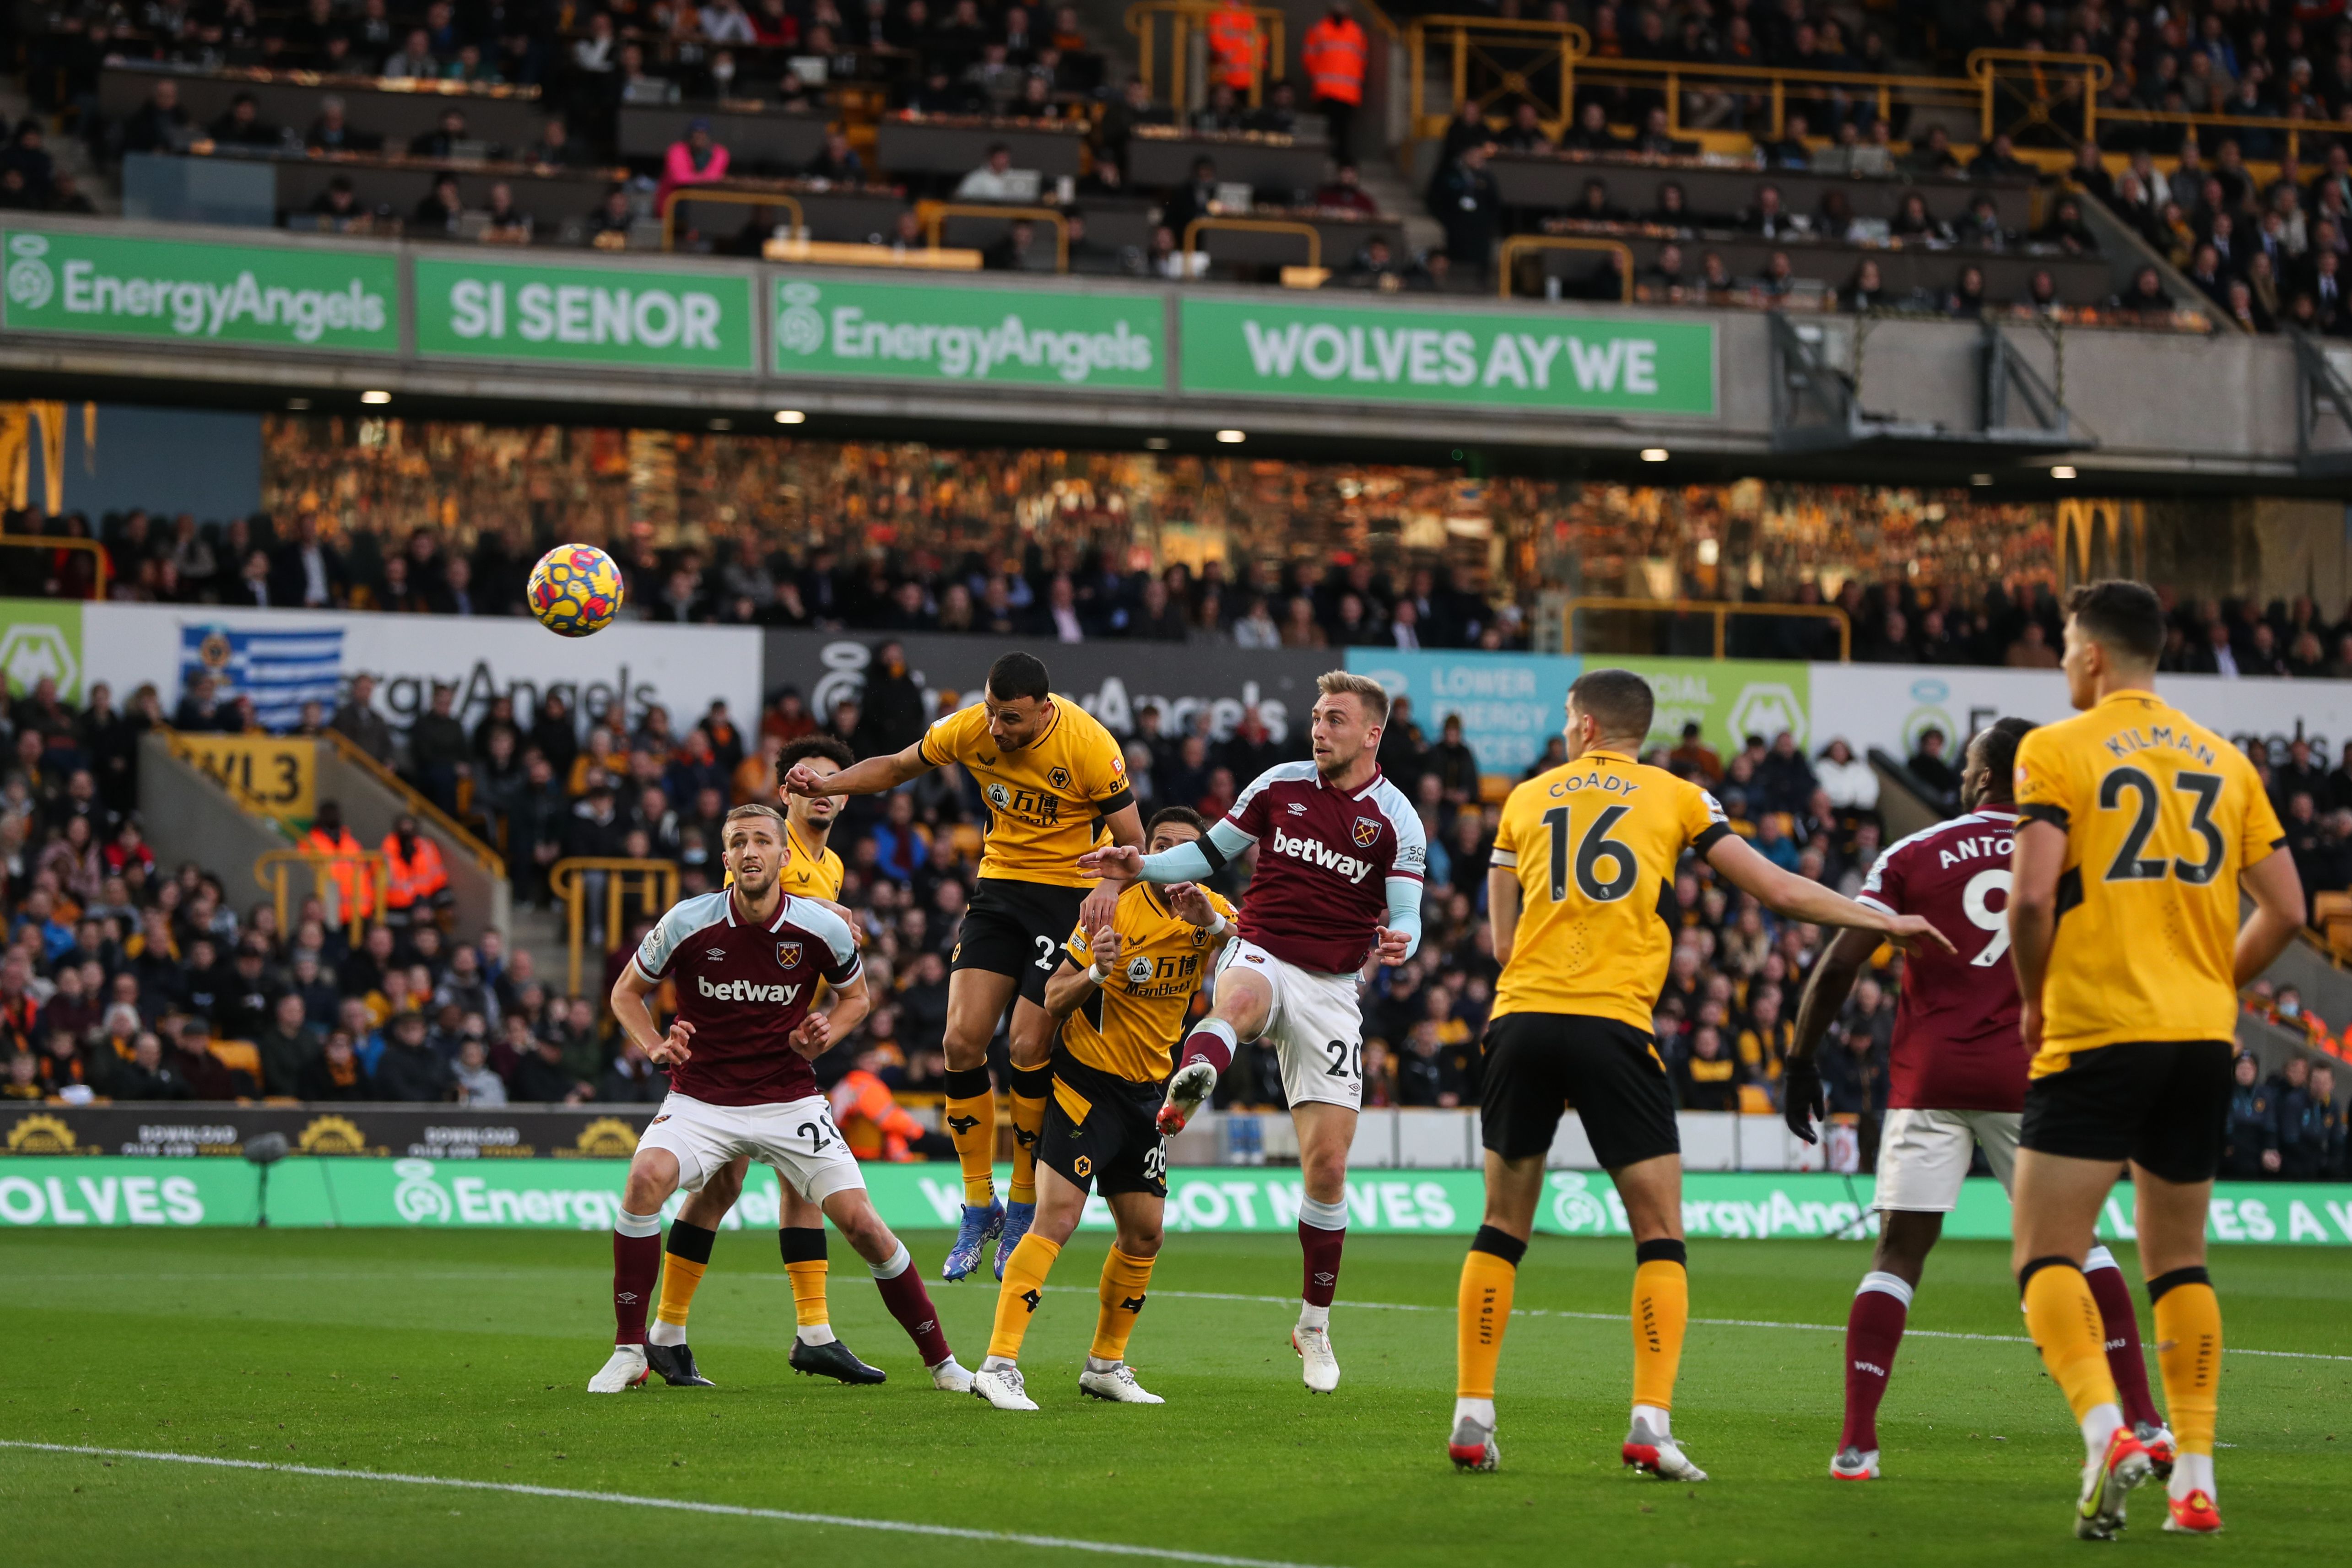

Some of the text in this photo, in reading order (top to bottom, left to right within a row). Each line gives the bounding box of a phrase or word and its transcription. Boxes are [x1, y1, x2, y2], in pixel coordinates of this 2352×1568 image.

[63, 260, 386, 343] EnergyAngels
[450, 278, 721, 350] SI SENOR
[831, 305, 1153, 384] EnergyAngels
[1243, 319, 1659, 395] WOLVES AY WE
[1431, 666, 1536, 700] LOWER
[2104, 726, 2215, 767] KILMAN
[1549, 772, 1640, 798] COADY
[2099, 766, 2225, 885] 23
[1273, 827, 1374, 884] betway
[1540, 805, 1639, 903] 16
[1963, 869, 2015, 967] 9
[698, 975, 802, 1006] betway
[1123, 979, 1192, 997] ManBetX
[1155, 954, 1199, 979] 万博
[1325, 1039, 1362, 1080] 20
[1269, 1180, 1456, 1229] NVES
[1854, 1360, 1885, 1376] WHU
